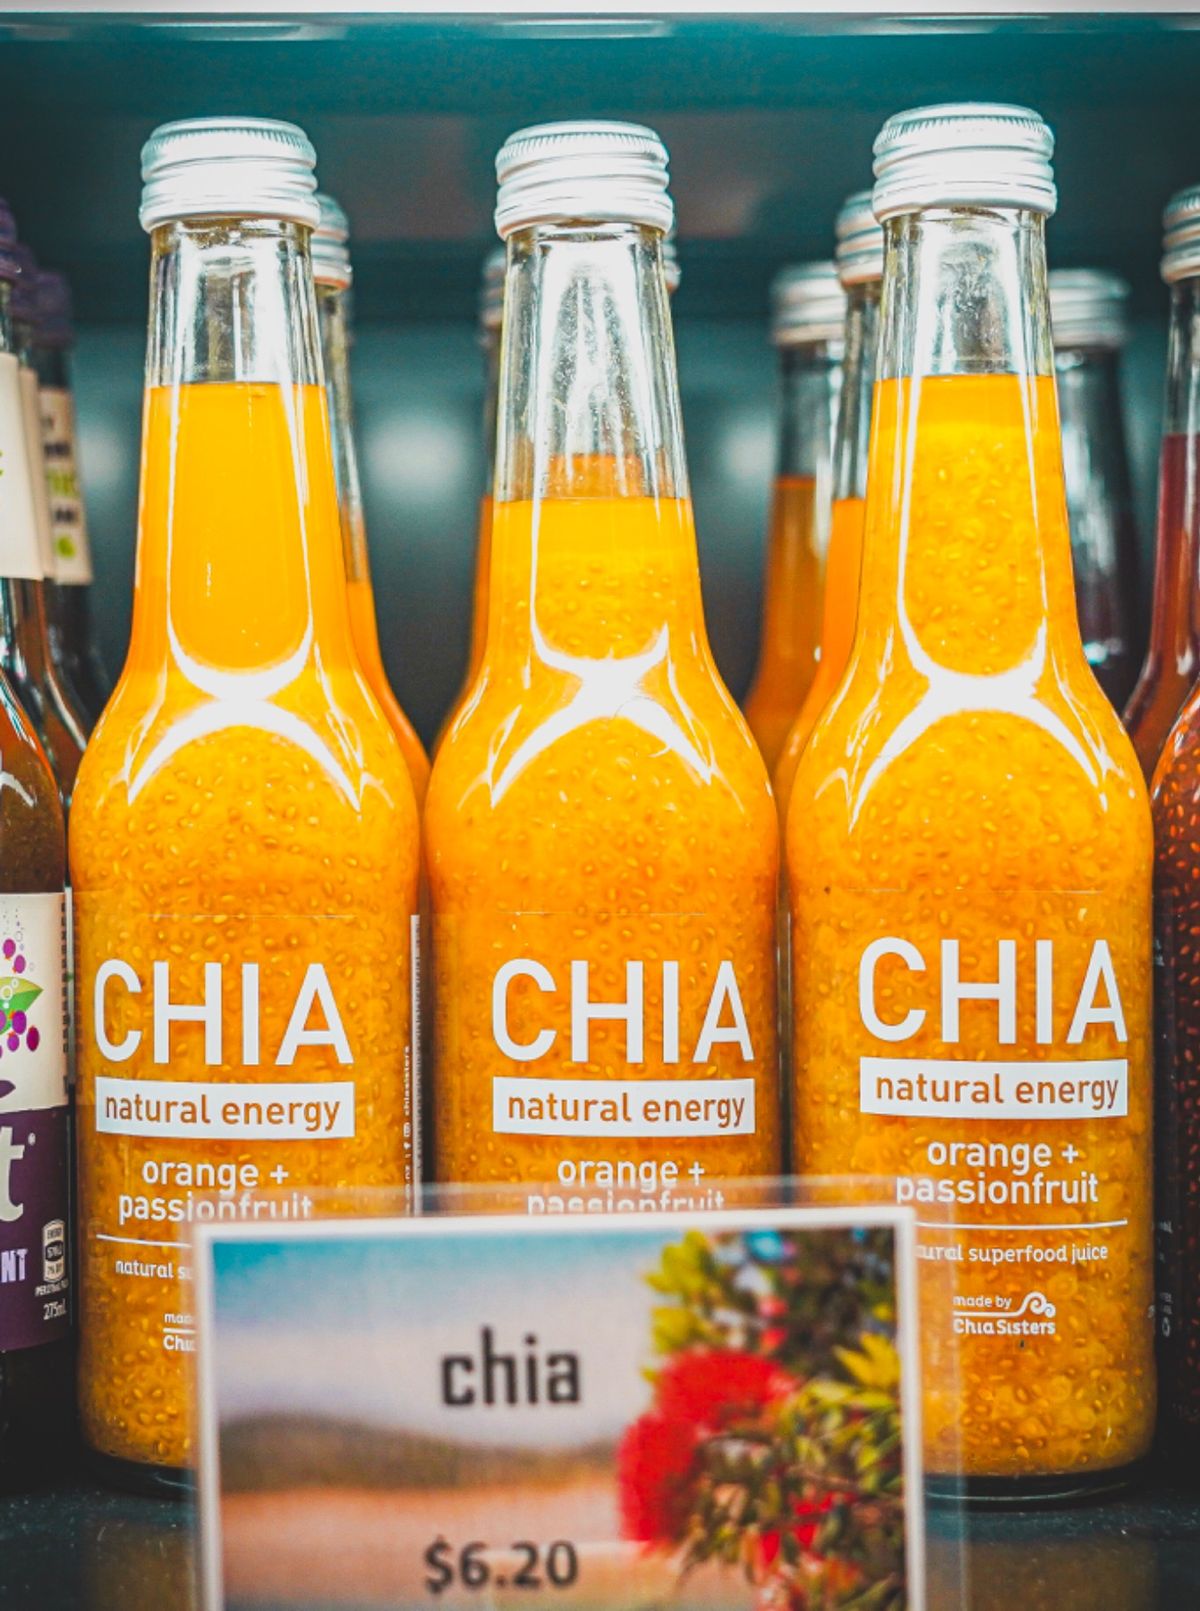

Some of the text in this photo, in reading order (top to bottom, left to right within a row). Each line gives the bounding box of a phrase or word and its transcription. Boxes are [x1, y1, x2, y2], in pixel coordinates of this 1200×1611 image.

[858, 937, 1128, 1044] CHIA
[95, 959, 354, 1065] CHIA
[492, 958, 754, 1064] CHIA
[876, 1073, 1119, 1111] natural energy
[105, 1093, 340, 1131] natural energy
[508, 1093, 745, 1128] natural energy
[927, 1141, 1079, 1175] orange +
[142, 1160, 289, 1197] orange +
[557, 1160, 705, 1193] orange +
[896, 1172, 1099, 1205] passionfruit
[118, 1191, 313, 1225] passionfruit
[115, 1260, 174, 1279] natural
[968, 1244, 1067, 1265] superfood
[1071, 1244, 1108, 1264] juice
[953, 1295, 1012, 1309] made by
[953, 1318, 1056, 1335] Chia Sisters
[441, 1324, 580, 1407] chia
[425, 1535, 578, 1595] $6.20
